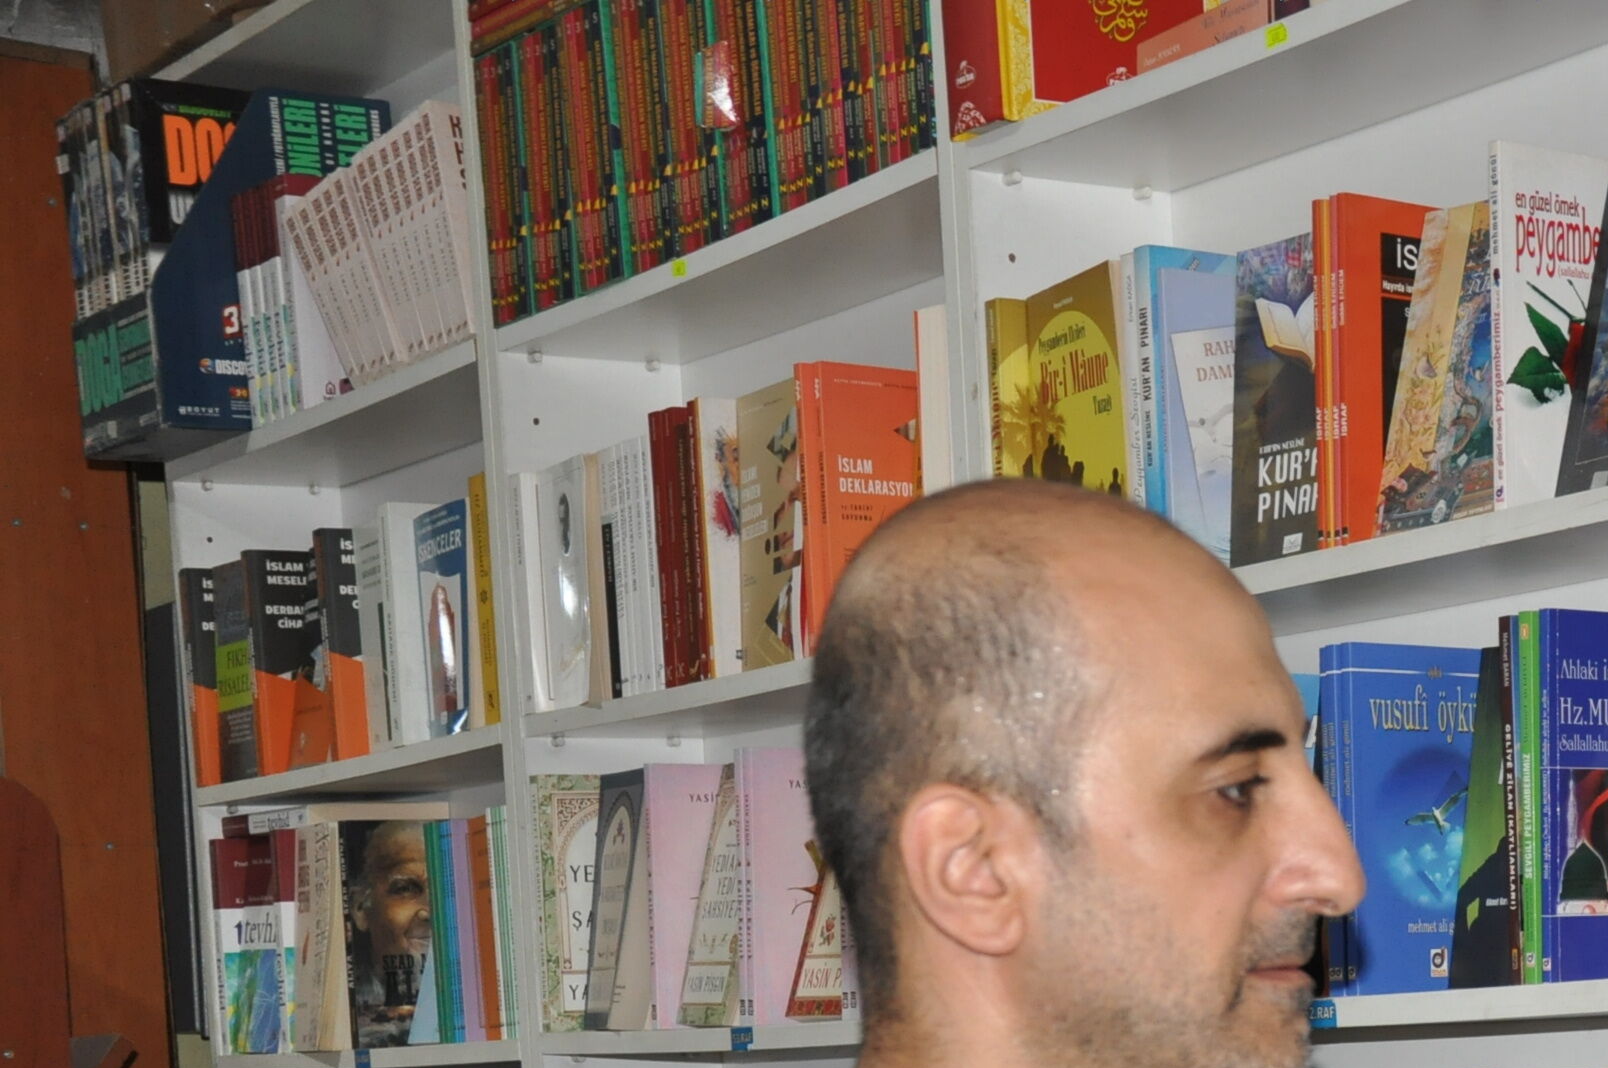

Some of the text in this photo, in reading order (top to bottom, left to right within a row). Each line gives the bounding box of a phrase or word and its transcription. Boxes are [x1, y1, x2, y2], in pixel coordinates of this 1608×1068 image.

[1516, 191, 1579, 217] en güzel örnek
[1491, 214, 1499, 255] mehmet
[1139, 307, 1150, 348] PINARI
[1493, 311, 1505, 412] peygamberimiz
[838, 454, 872, 474] İSLAM
[1559, 659, 1598, 681] Ahlaki
[1408, 920, 1438, 935] mehmet
